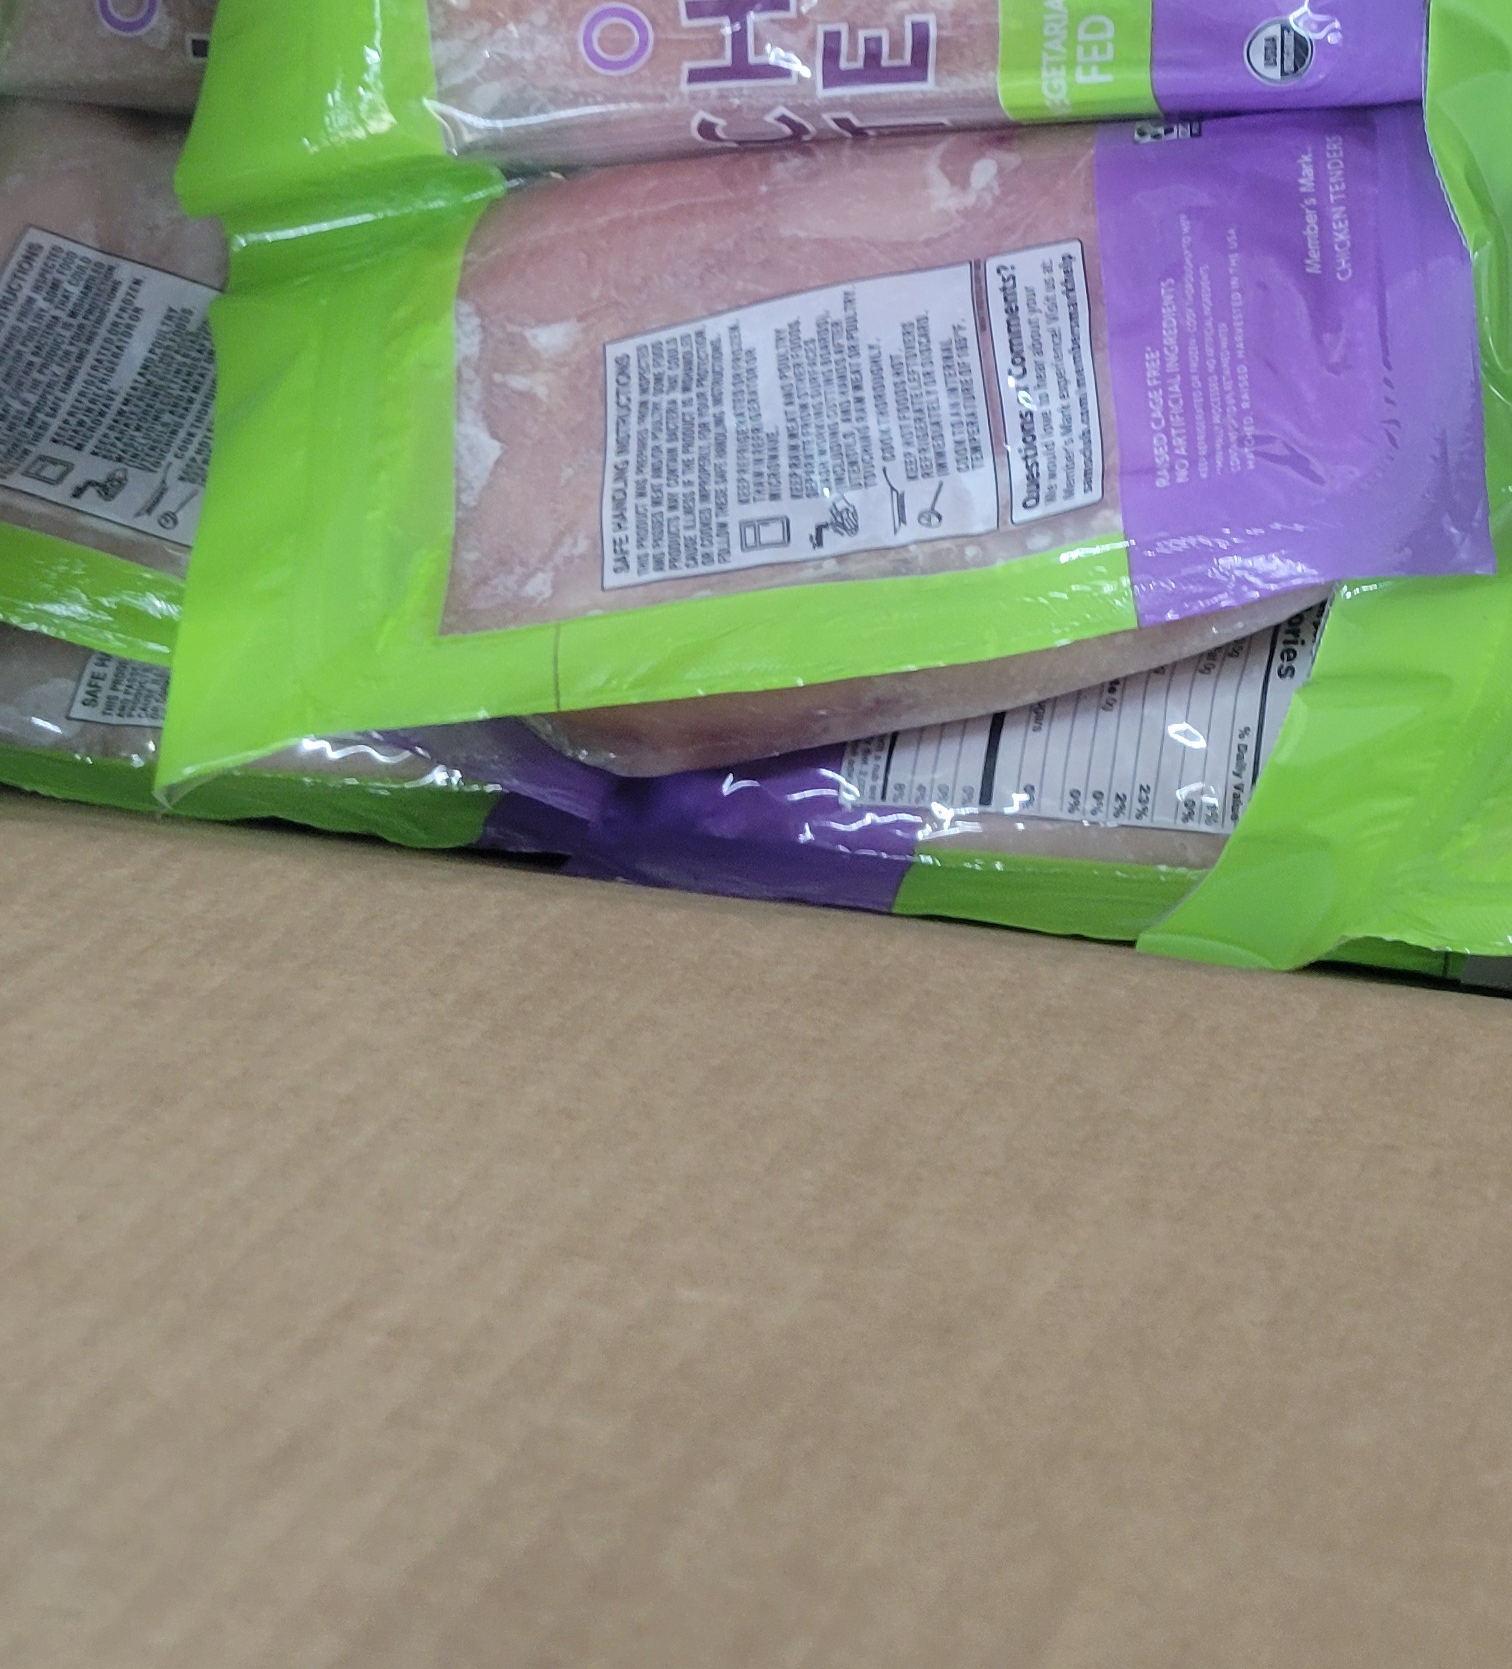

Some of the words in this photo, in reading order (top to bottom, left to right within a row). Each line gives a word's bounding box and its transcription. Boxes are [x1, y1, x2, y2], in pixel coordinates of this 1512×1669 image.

[1075, 14, 1114, 83] FED
[1325, 135, 1346, 203] TENDERS
[1301, 198, 1322, 273] Member's
[1332, 205, 1352, 281] CHICKEN
[1228, 253, 1239, 274] THE
[1024, 285, 1042, 316] your
[1043, 277, 1055, 292] us
[1230, 277, 1239, 290] IN
[996, 264, 1027, 379] Comments?
[1044, 294, 1059, 325] Visit
[1161, 277, 1179, 372] INGREDIENTS
[1231, 292, 1245, 358] HARVESTED
[829, 319, 845, 355] AFTER
[1027, 317, 1044, 357] about
[939, 338, 958, 399] INTERNAL
[960, 361, 973, 376] OF
[1032, 359, 1047, 390] hear
[614, 353, 631, 458] INSTRUCTIONS
[1038, 393, 1049, 406] to
[1149, 388, 1165, 430] CAGE
[1167, 374, 1187, 455] ARTIFICIAL
[681, 412, 695, 454] PRODUCT
[950, 421, 964, 436] TO
[963, 376, 985, 470] TEMPERATURE
[1041, 410, 1054, 438] love
[1058, 403, 1073, 436] Mark
[879, 429, 896, 462] COOK
[953, 440, 969, 473] COOK
[1018, 410, 1040, 509] Questions
[1040, 441, 1057, 479] would
[1153, 433, 1170, 488] RAISED
[681, 457, 695, 477] THE
[902, 452, 919, 482] KEEP
[1061, 437, 1076, 501] Member's
[1175, 459, 1189, 483] NO
[611, 460, 629, 533] HANDLING
[1043, 482, 1057, 505] We
[612, 535, 630, 574] SAFE
[81, 672, 107, 708] SAFE
[1238, 726, 1251, 739] %
[1232, 744, 1248, 778] Daily
[1067, 788, 1081, 814] 0%
[1089, 790, 1104, 816] 0%
[1112, 792, 1127, 818] 2%
[1134, 783, 1151, 820] 23%
